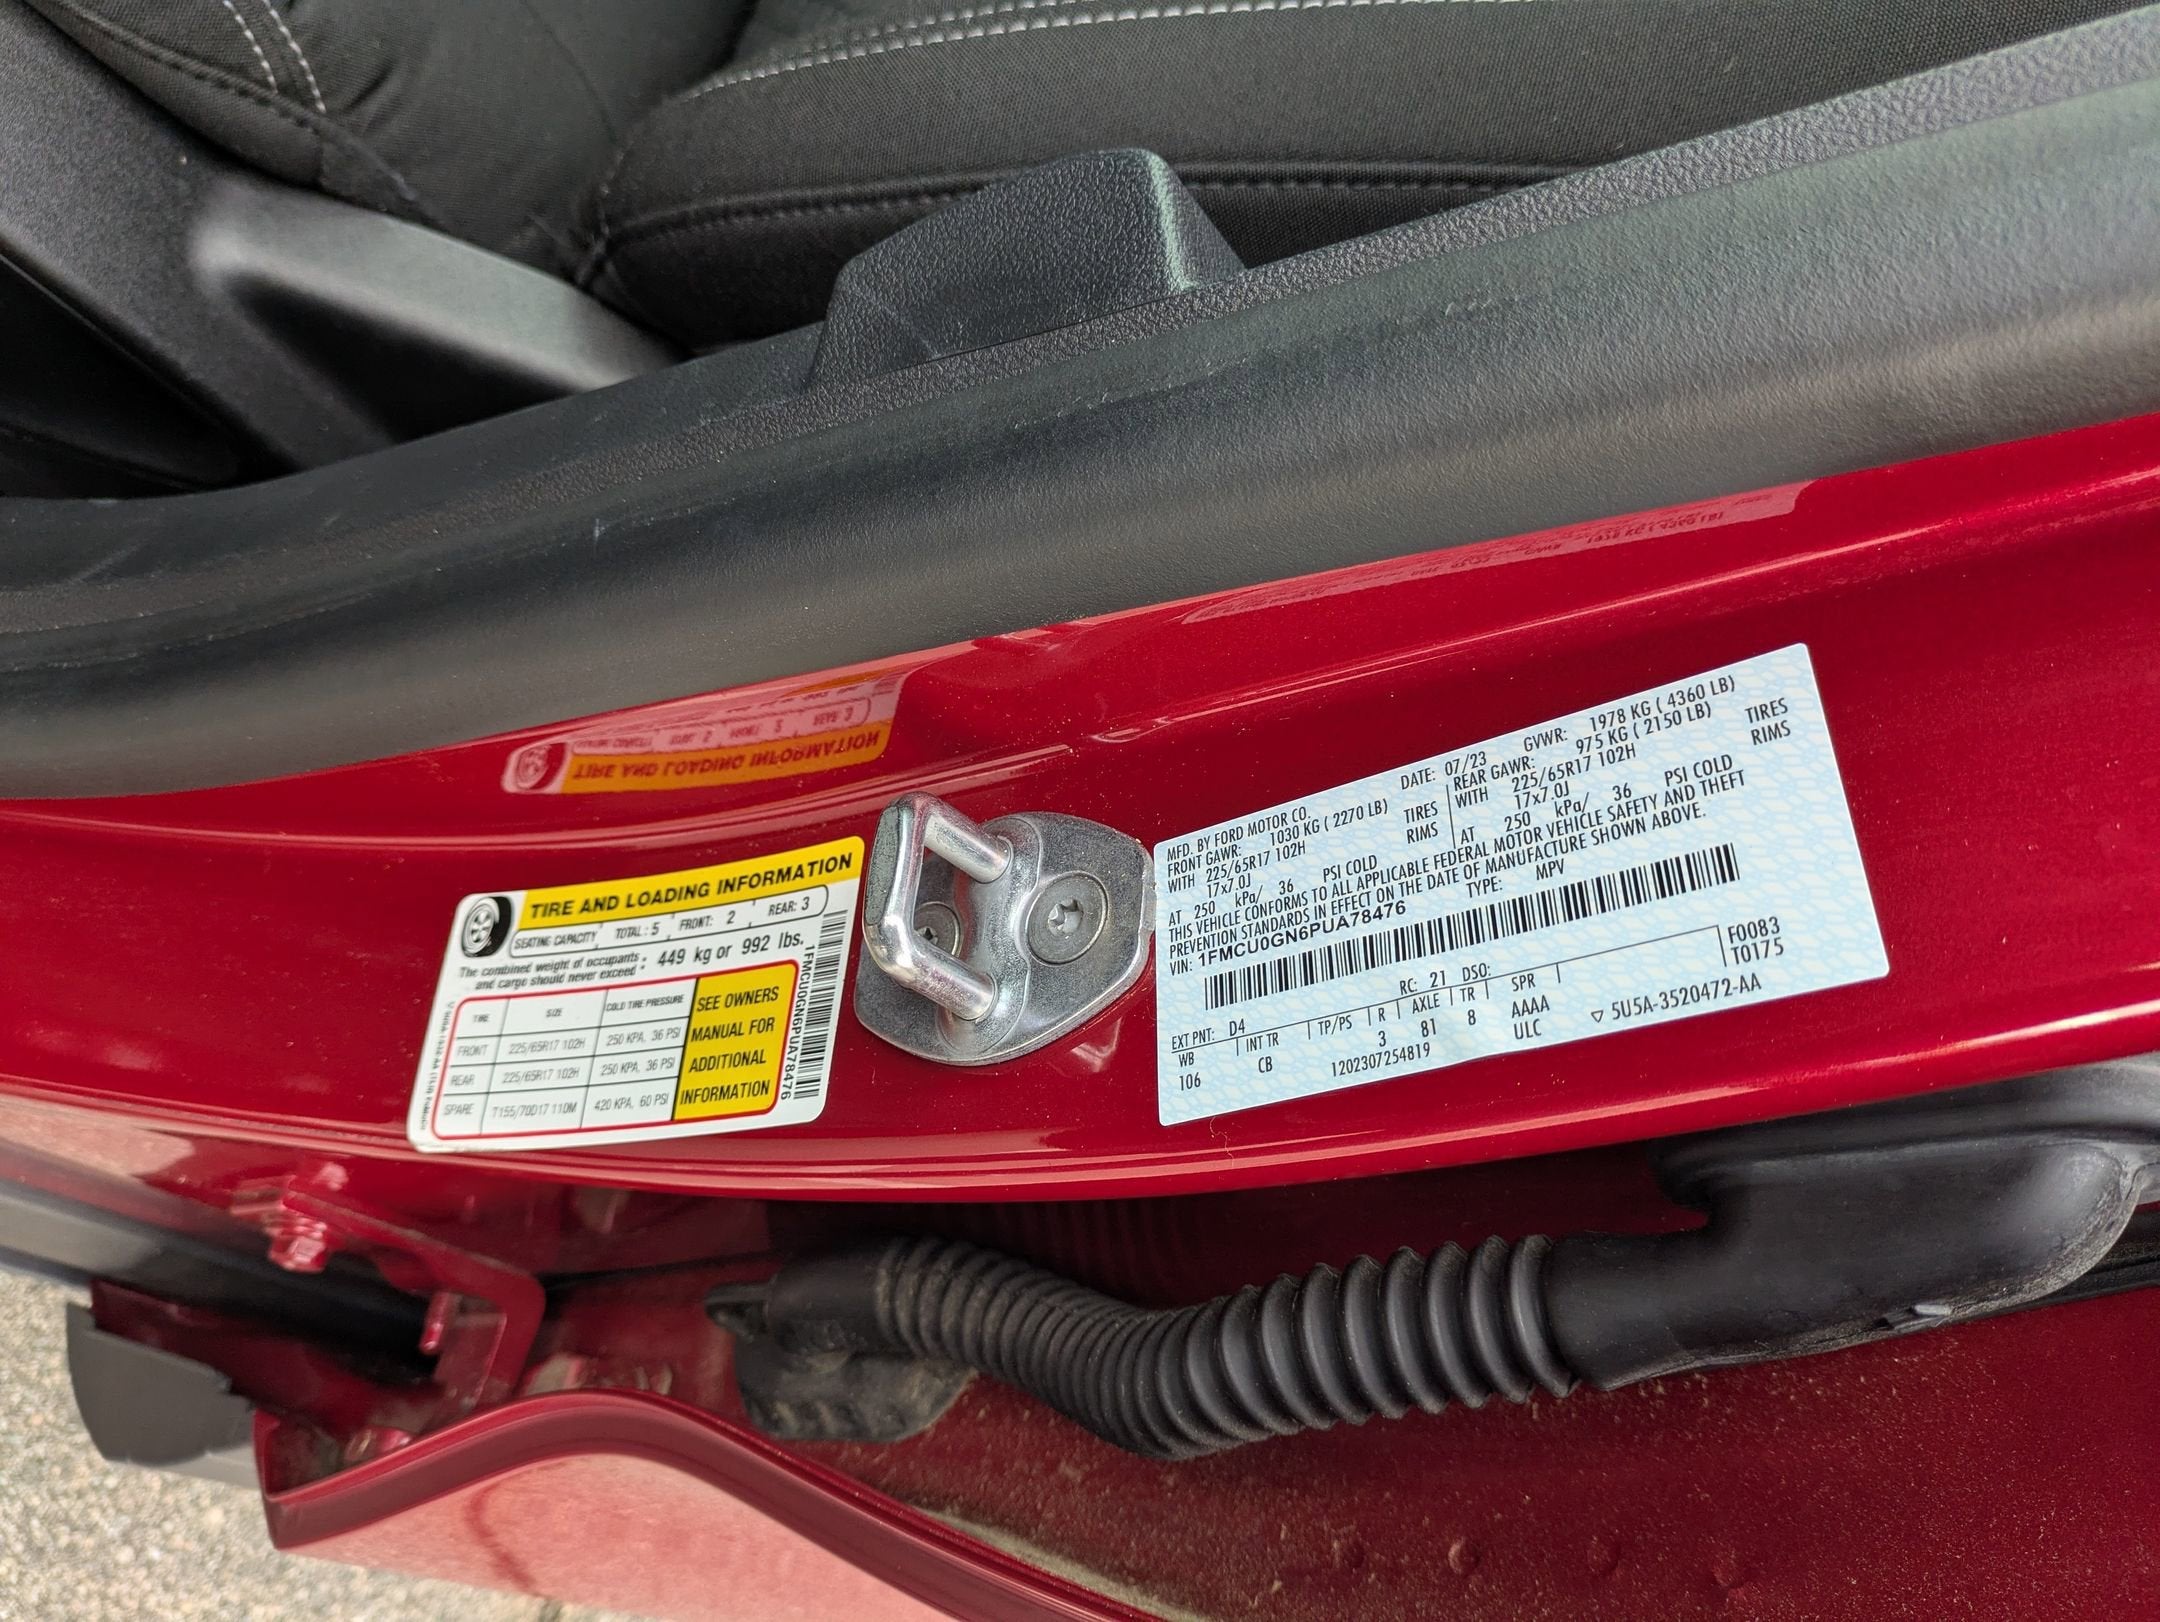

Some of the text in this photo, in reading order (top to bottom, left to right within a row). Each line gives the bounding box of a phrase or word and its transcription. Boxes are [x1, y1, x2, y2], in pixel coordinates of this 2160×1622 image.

[1523, 674, 1735, 752] GVWR: 1978 KG 4360 LB)
[1453, 701, 1712, 792] REAR GAWR: 975 KG 2150 LB)
[1455, 698, 1788, 809] WITH 225/65R17 102H TIRES
[1401, 751, 1487, 791] DATE: 07/23
[1514, 720, 1791, 810] 17x7.0J RIMS
[1461, 754, 1733, 845] AT 250 kPa/ 36 PSI COLD
[1167, 806, 1311, 862] MFD. BY FORD MOTOR CO.
[1168, 798, 1388, 877] FRONT GAWR: 1030 KG 2270 LB)
[1168, 801, 1438, 894] WITH 225/65R17 102H TIRES
[1168, 769, 1745, 943] THIS VEHICLE CONFORMS TO ALL APPLICABLE FEDERAL MOTOR VEHICLE SAFETY AND THEFT
[1207, 822, 1439, 898] 17x7.0J RIMS
[531, 852, 852, 919] TIRE AND LOADING INFORMATION
[1168, 855, 1377, 927] AT 250 kPa/ 36 PSI COLD
[1169, 802, 1706, 959] PREVENTION STANDARDS IN EFFECT ON THE DATE OF MANUFACTURE SHOWN ABOVE.
[1466, 858, 1565, 898] TYPE: MPV
[768, 896, 810, 917] REAR: 3
[679, 911, 736, 931] FRONT: 2
[1727, 917, 1781, 945] F0083
[514, 931, 597, 950] SEATING CAPACITY
[658, 932, 804, 967] 449 kg or 992 lbs.
[1169, 900, 1406, 976] VIN: 1FMCU0GN6PUA78476
[1731, 937, 1784, 966] T0175
[1400, 963, 1491, 996] RC: 21 DSO:
[1511, 974, 1536, 993] SPR
[696, 985, 780, 1012] SEE OWNERS
[1412, 992, 1440, 1014] AXLE
[1460, 986, 1476, 1003] TR
[1511, 995, 1550, 1019] AAAA
[1612, 973, 1763, 1021] 5U5A-3520472-AA
[780, 945, 815, 1101] 1FMCU0GN6PUA78476
[1318, 1015, 1352, 1036] TP/PS
[1378, 1007, 1386, 1022] R
[1421, 1018, 1436, 1038] 81
[1467, 1010, 1477, 1027] 8
[651, 1026, 681, 1040] 36 PSI
[691, 1017, 775, 1043] MANUAL FOR
[1172, 1018, 1246, 1050] EXT PNT: D4
[1246, 1032, 1279, 1052] INT TR
[1378, 1031, 1386, 1048] 3
[1515, 1018, 1542, 1041] ULC
[600, 1056, 676, 1077] 250 36 PSI
[688, 1049, 767, 1074] ADDITIONAL
[1179, 1052, 1195, 1068] WB
[1258, 1056, 1273, 1074] CB
[1332, 1042, 1430, 1077] 1202307254819
[680, 1079, 771, 1105] INFORMATION
[1179, 1072, 1201, 1091] 106
[594, 1091, 669, 1111] 420 60 PSI
